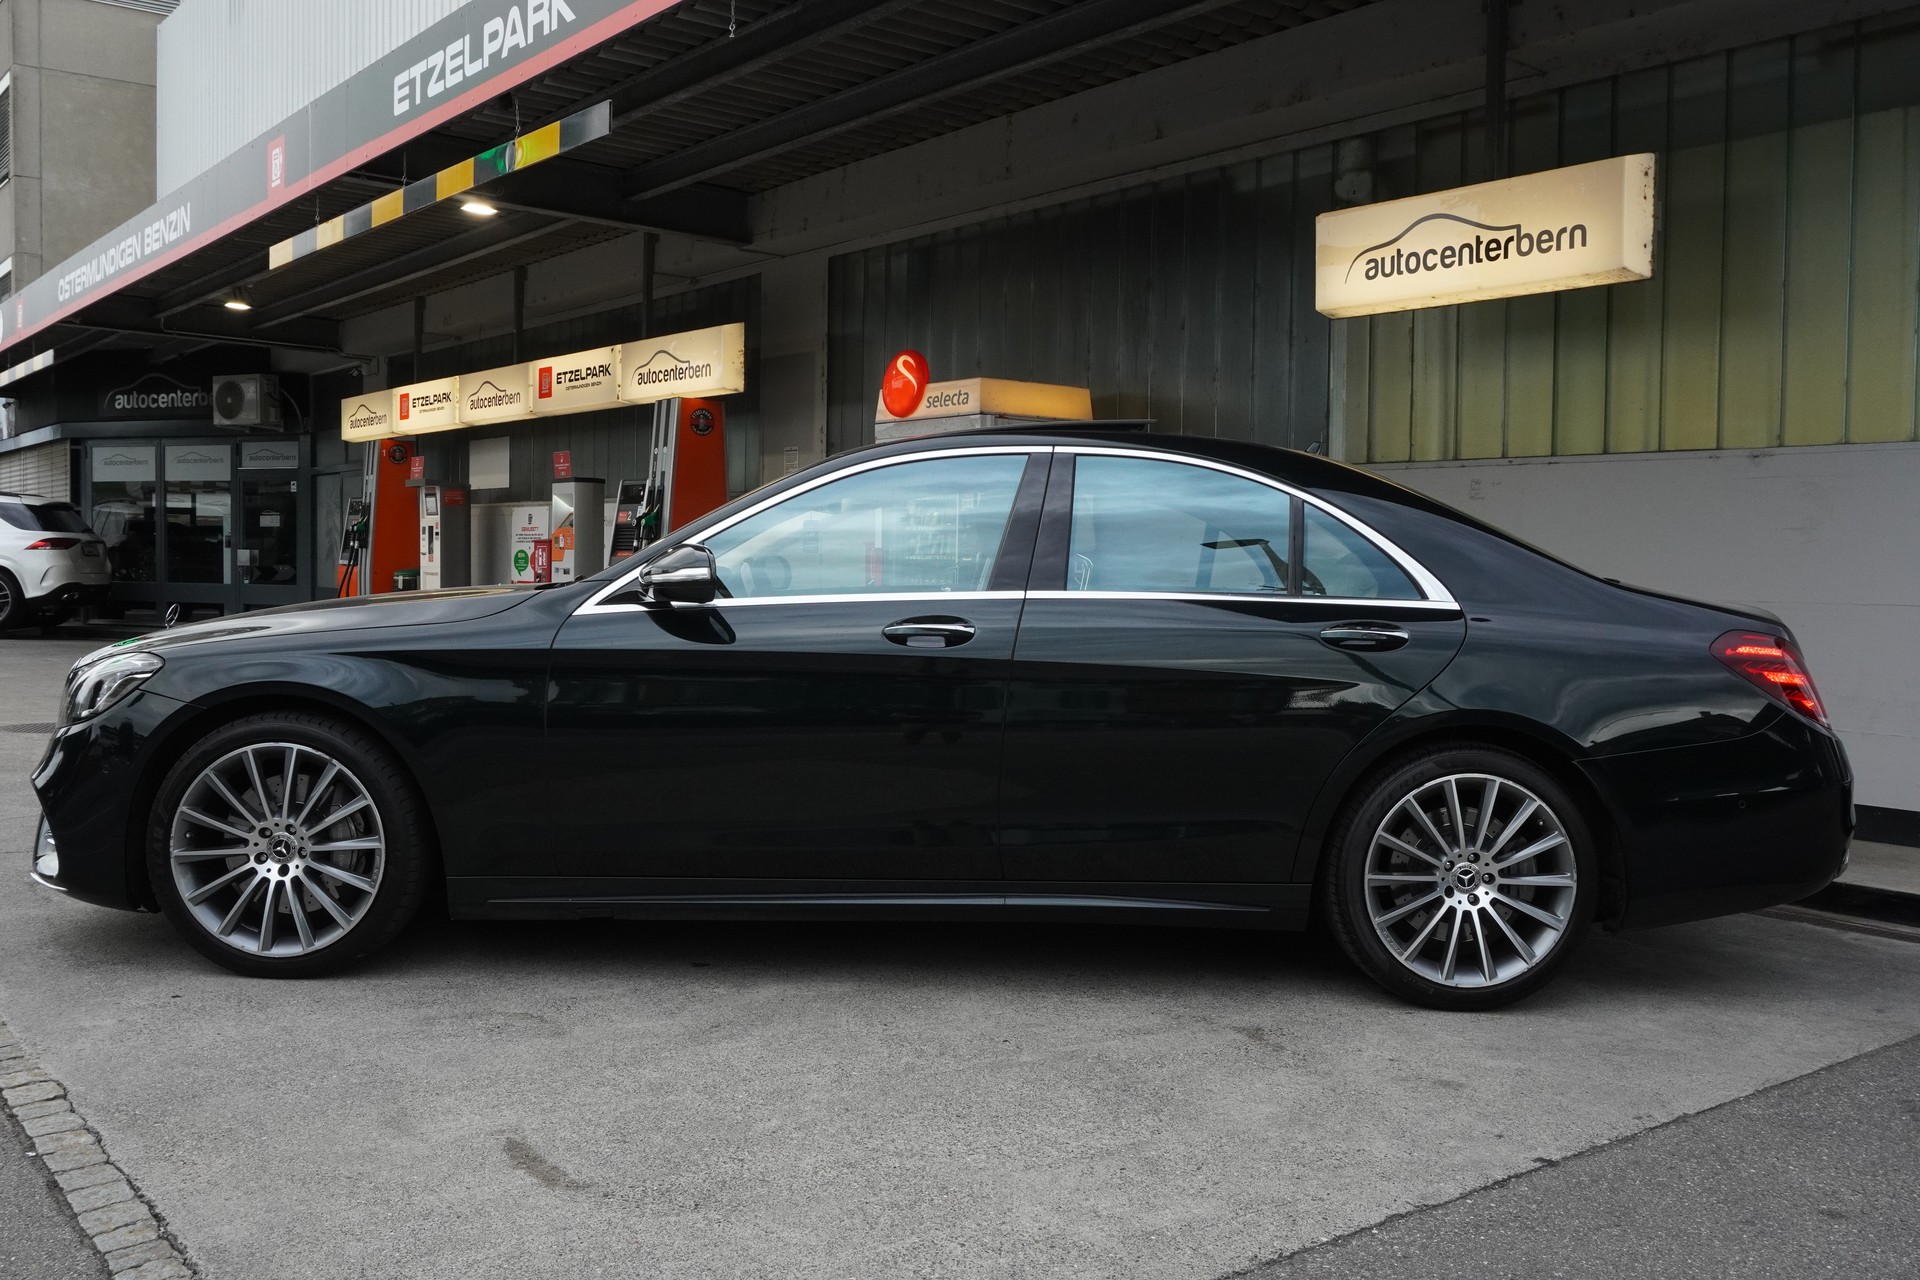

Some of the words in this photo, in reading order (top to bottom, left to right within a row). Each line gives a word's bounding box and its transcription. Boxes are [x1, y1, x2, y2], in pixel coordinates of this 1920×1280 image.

[394, 0, 576, 116] ETZELPARK
[58, 232, 141, 302] OSTERMUNDIGEN
[144, 202, 191, 256] BENZIN
[1365, 224, 1587, 281] autocenterbern
[556, 363, 612, 385] ETZELPARK
[637, 361, 712, 386] autocenterbern
[412, 391, 452, 409] ETZELPARK
[469, 390, 521, 411] autocenterbern
[926, 389, 969, 408] selecta
[349, 412, 387, 430] autocenterbern
[103, 458, 149, 466] autocenterbern
[176, 456, 224, 465] autocenterbern
[249, 453, 297, 462] autocenterbern
[627, 511, 632, 521] 2
